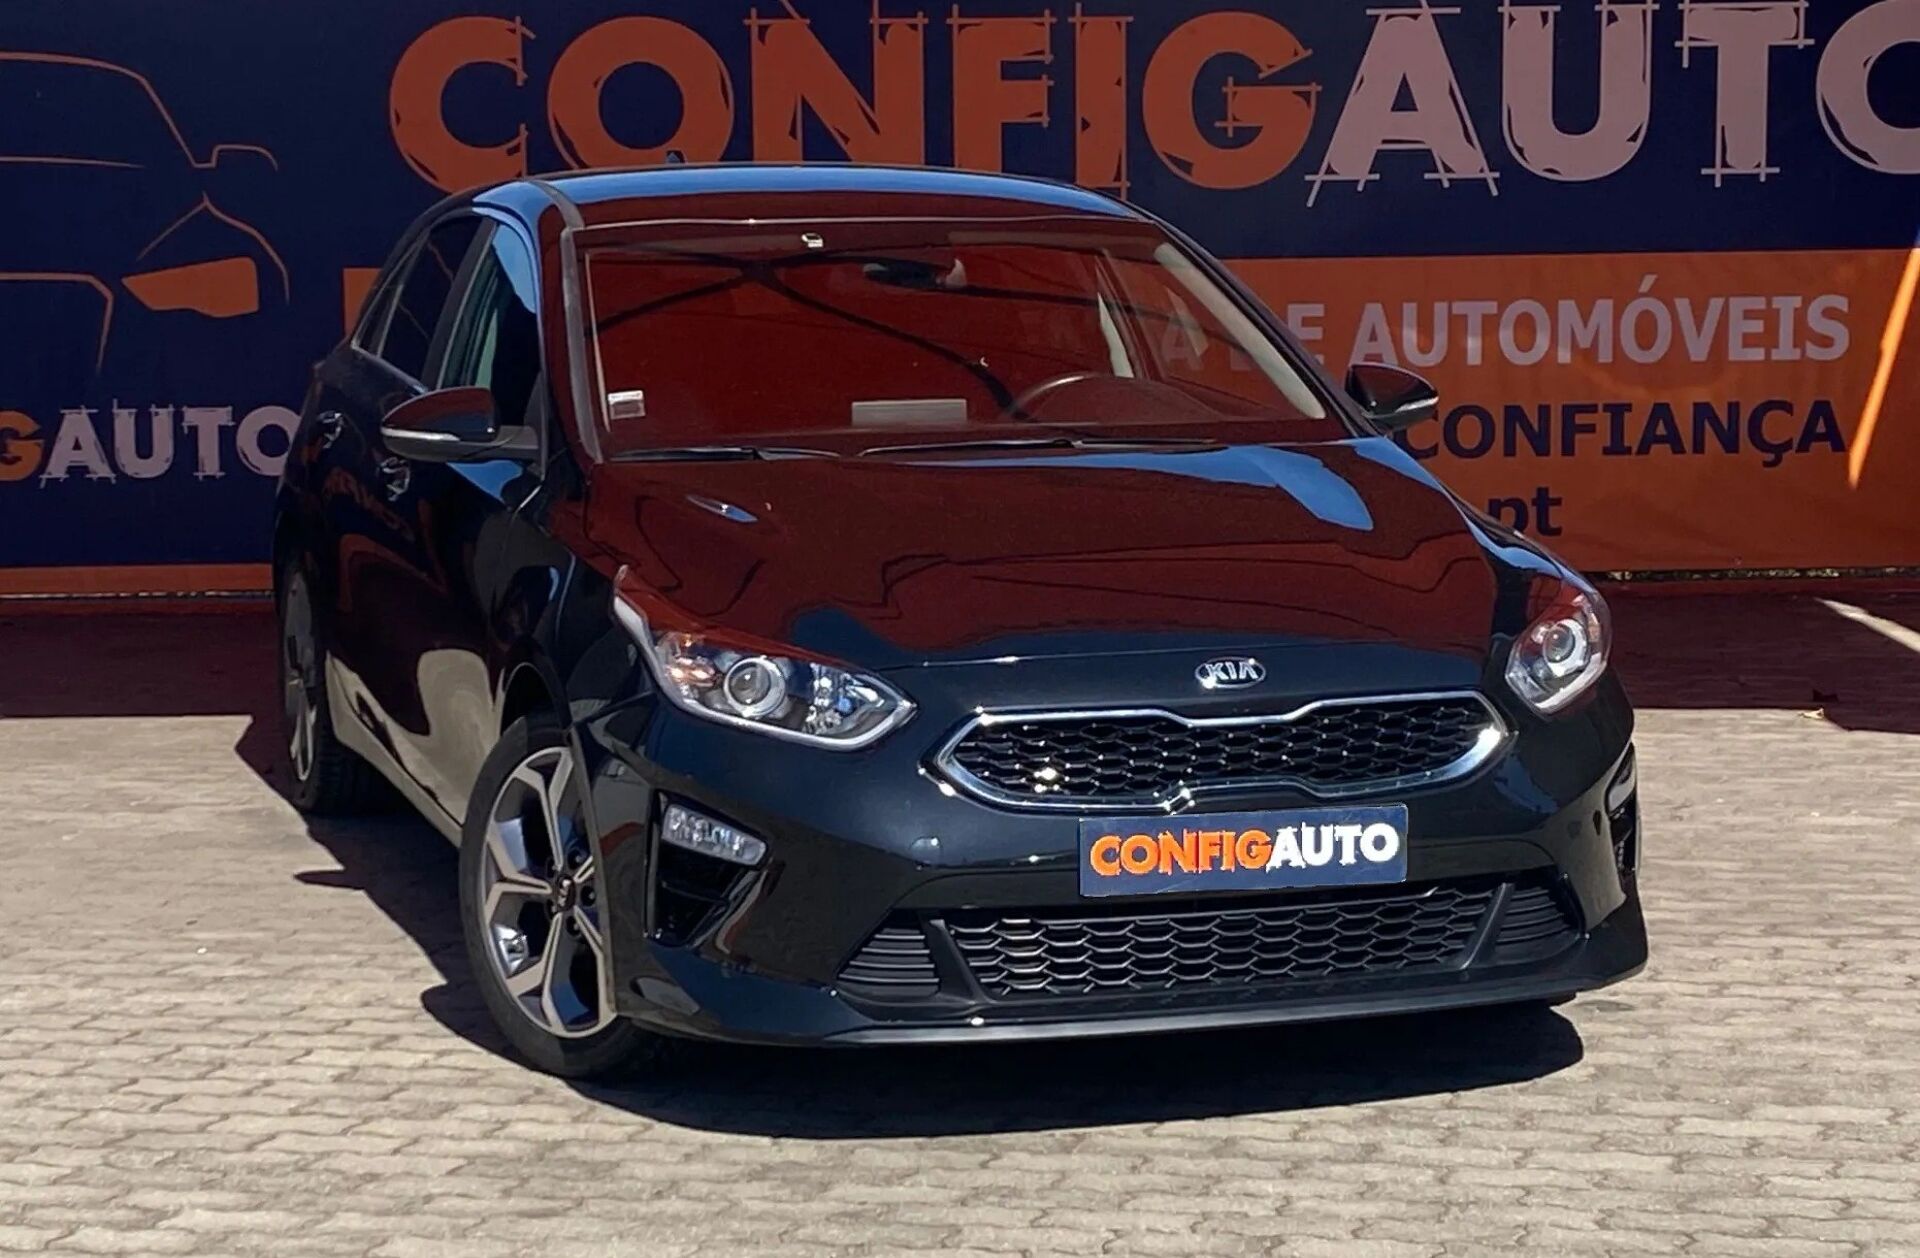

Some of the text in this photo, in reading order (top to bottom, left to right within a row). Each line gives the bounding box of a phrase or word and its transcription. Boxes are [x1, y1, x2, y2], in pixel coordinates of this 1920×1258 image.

[389, 0, 1920, 207] CONFIGAUTO
[1349, 274, 1850, 366] AUTOMÓVEIS
[1394, 399, 1846, 468] CONFIANÇA
[1203, 659, 1262, 683] KIA
[1090, 822, 1399, 875] CONFIGAUTO
